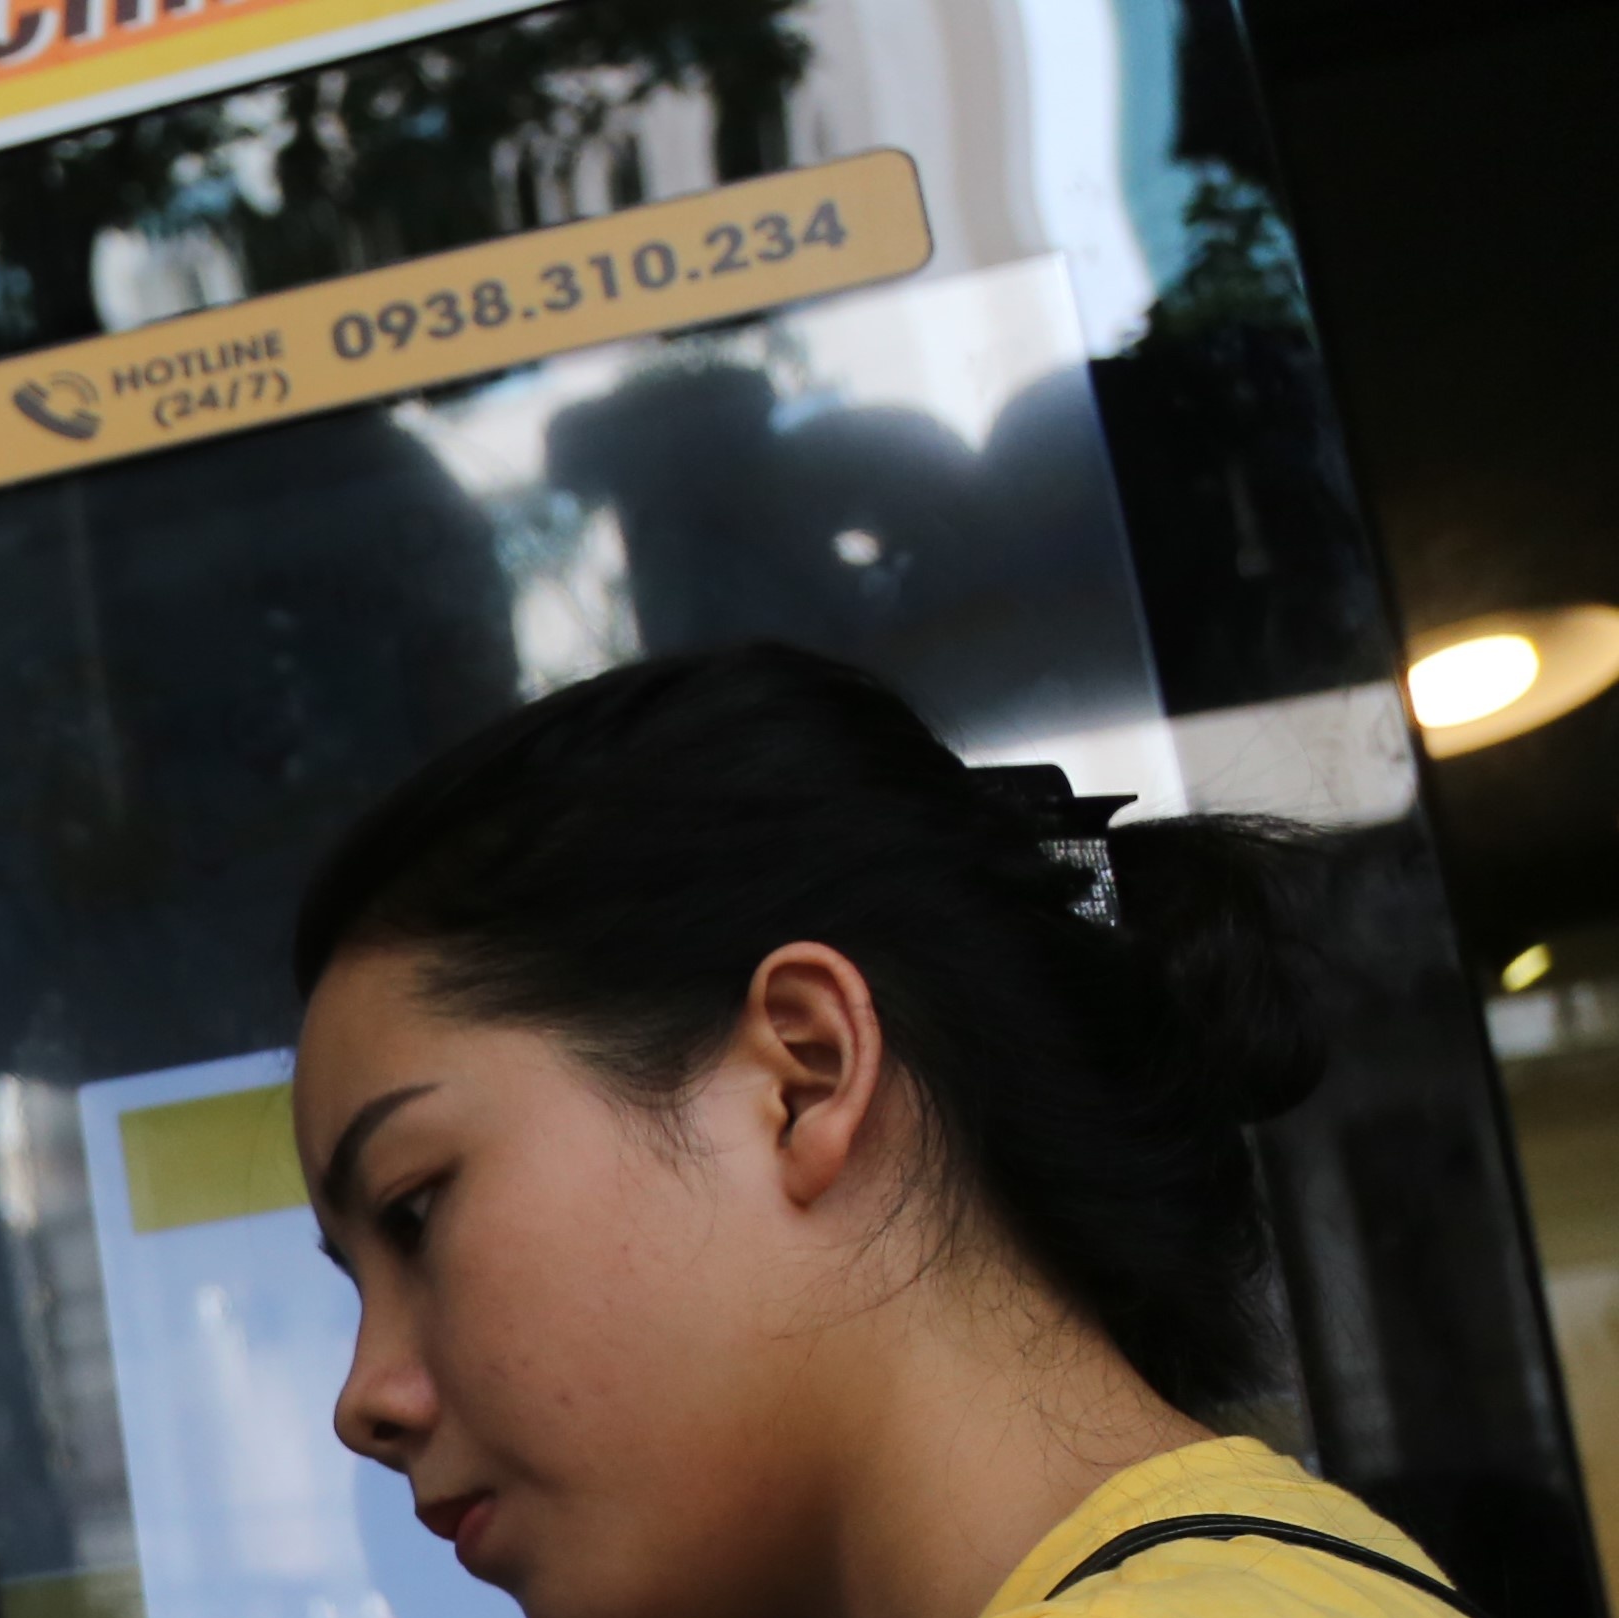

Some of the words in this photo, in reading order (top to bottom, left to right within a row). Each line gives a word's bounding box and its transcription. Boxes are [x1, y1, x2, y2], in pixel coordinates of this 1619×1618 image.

[329, 200, 848, 362] 0938.310.234
[110, 328, 283, 398] HOTLINE
[152, 366, 292, 430] (24/7)
